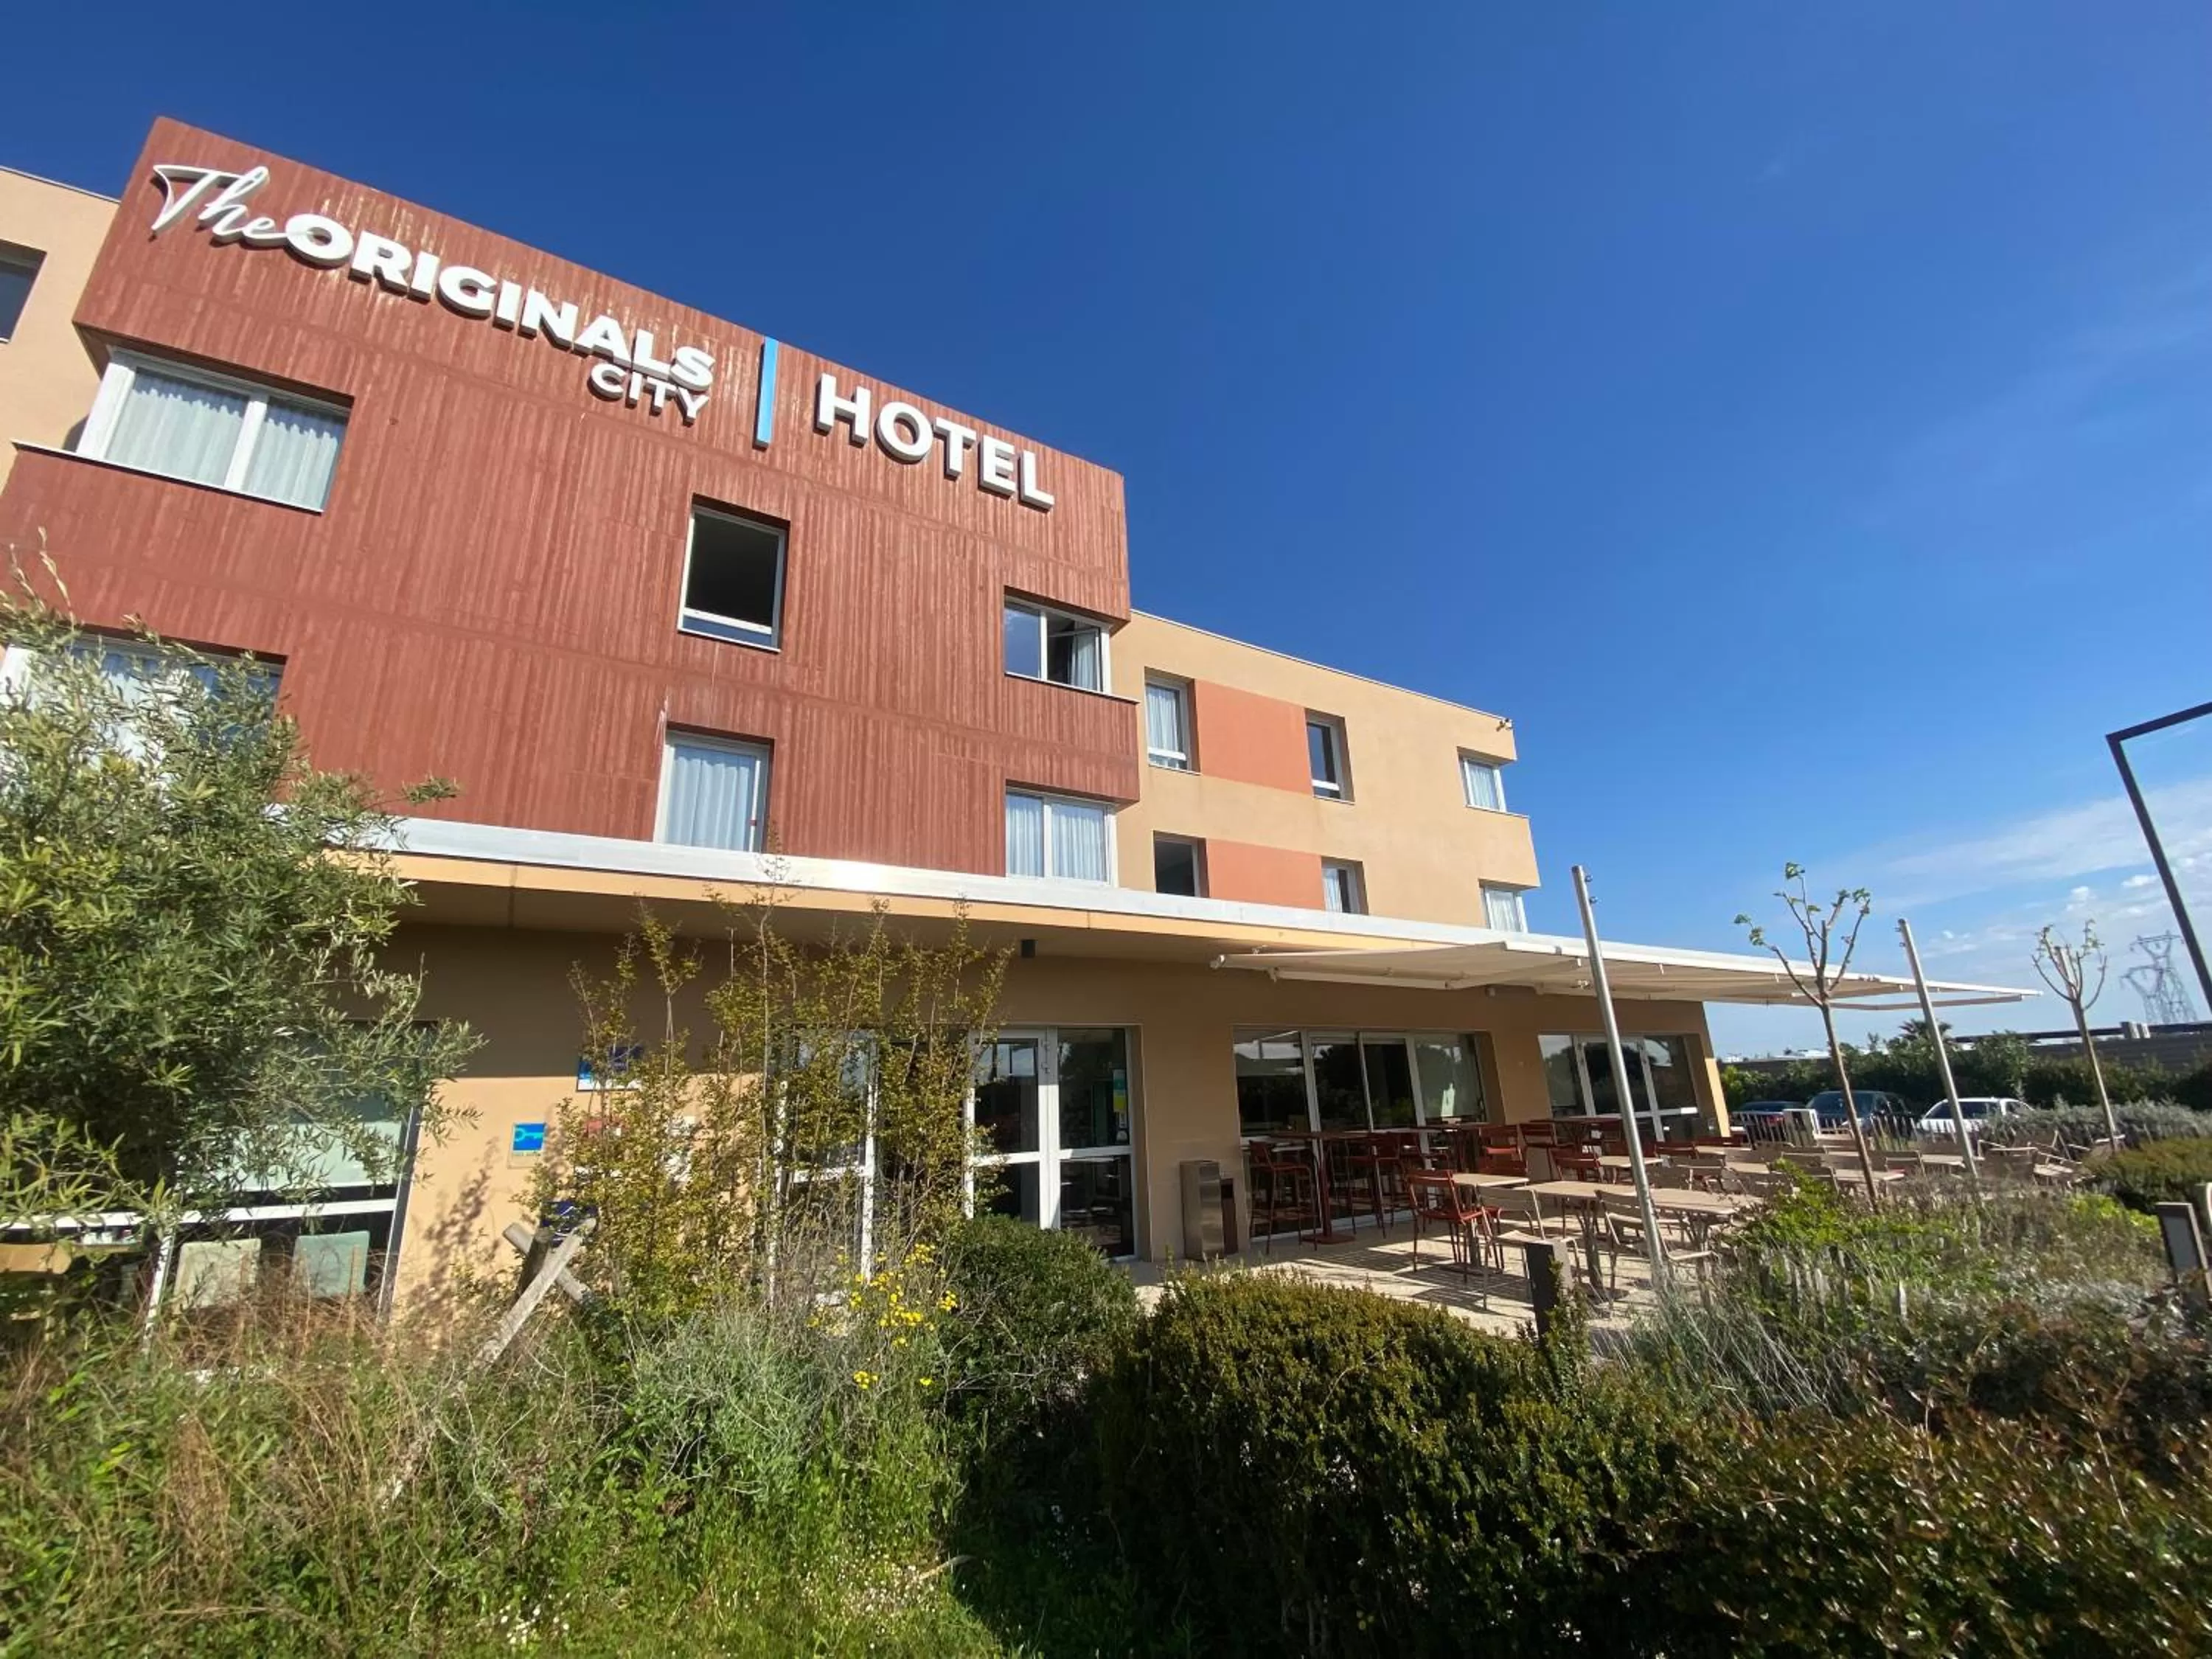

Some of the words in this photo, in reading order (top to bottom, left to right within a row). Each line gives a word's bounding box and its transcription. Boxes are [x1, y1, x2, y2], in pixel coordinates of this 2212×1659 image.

[151, 164, 289, 246] The
[285, 213, 716, 392] ORIGINALS
[589, 362, 710, 425] CITY
[815, 373, 1055, 511] HOTEL
